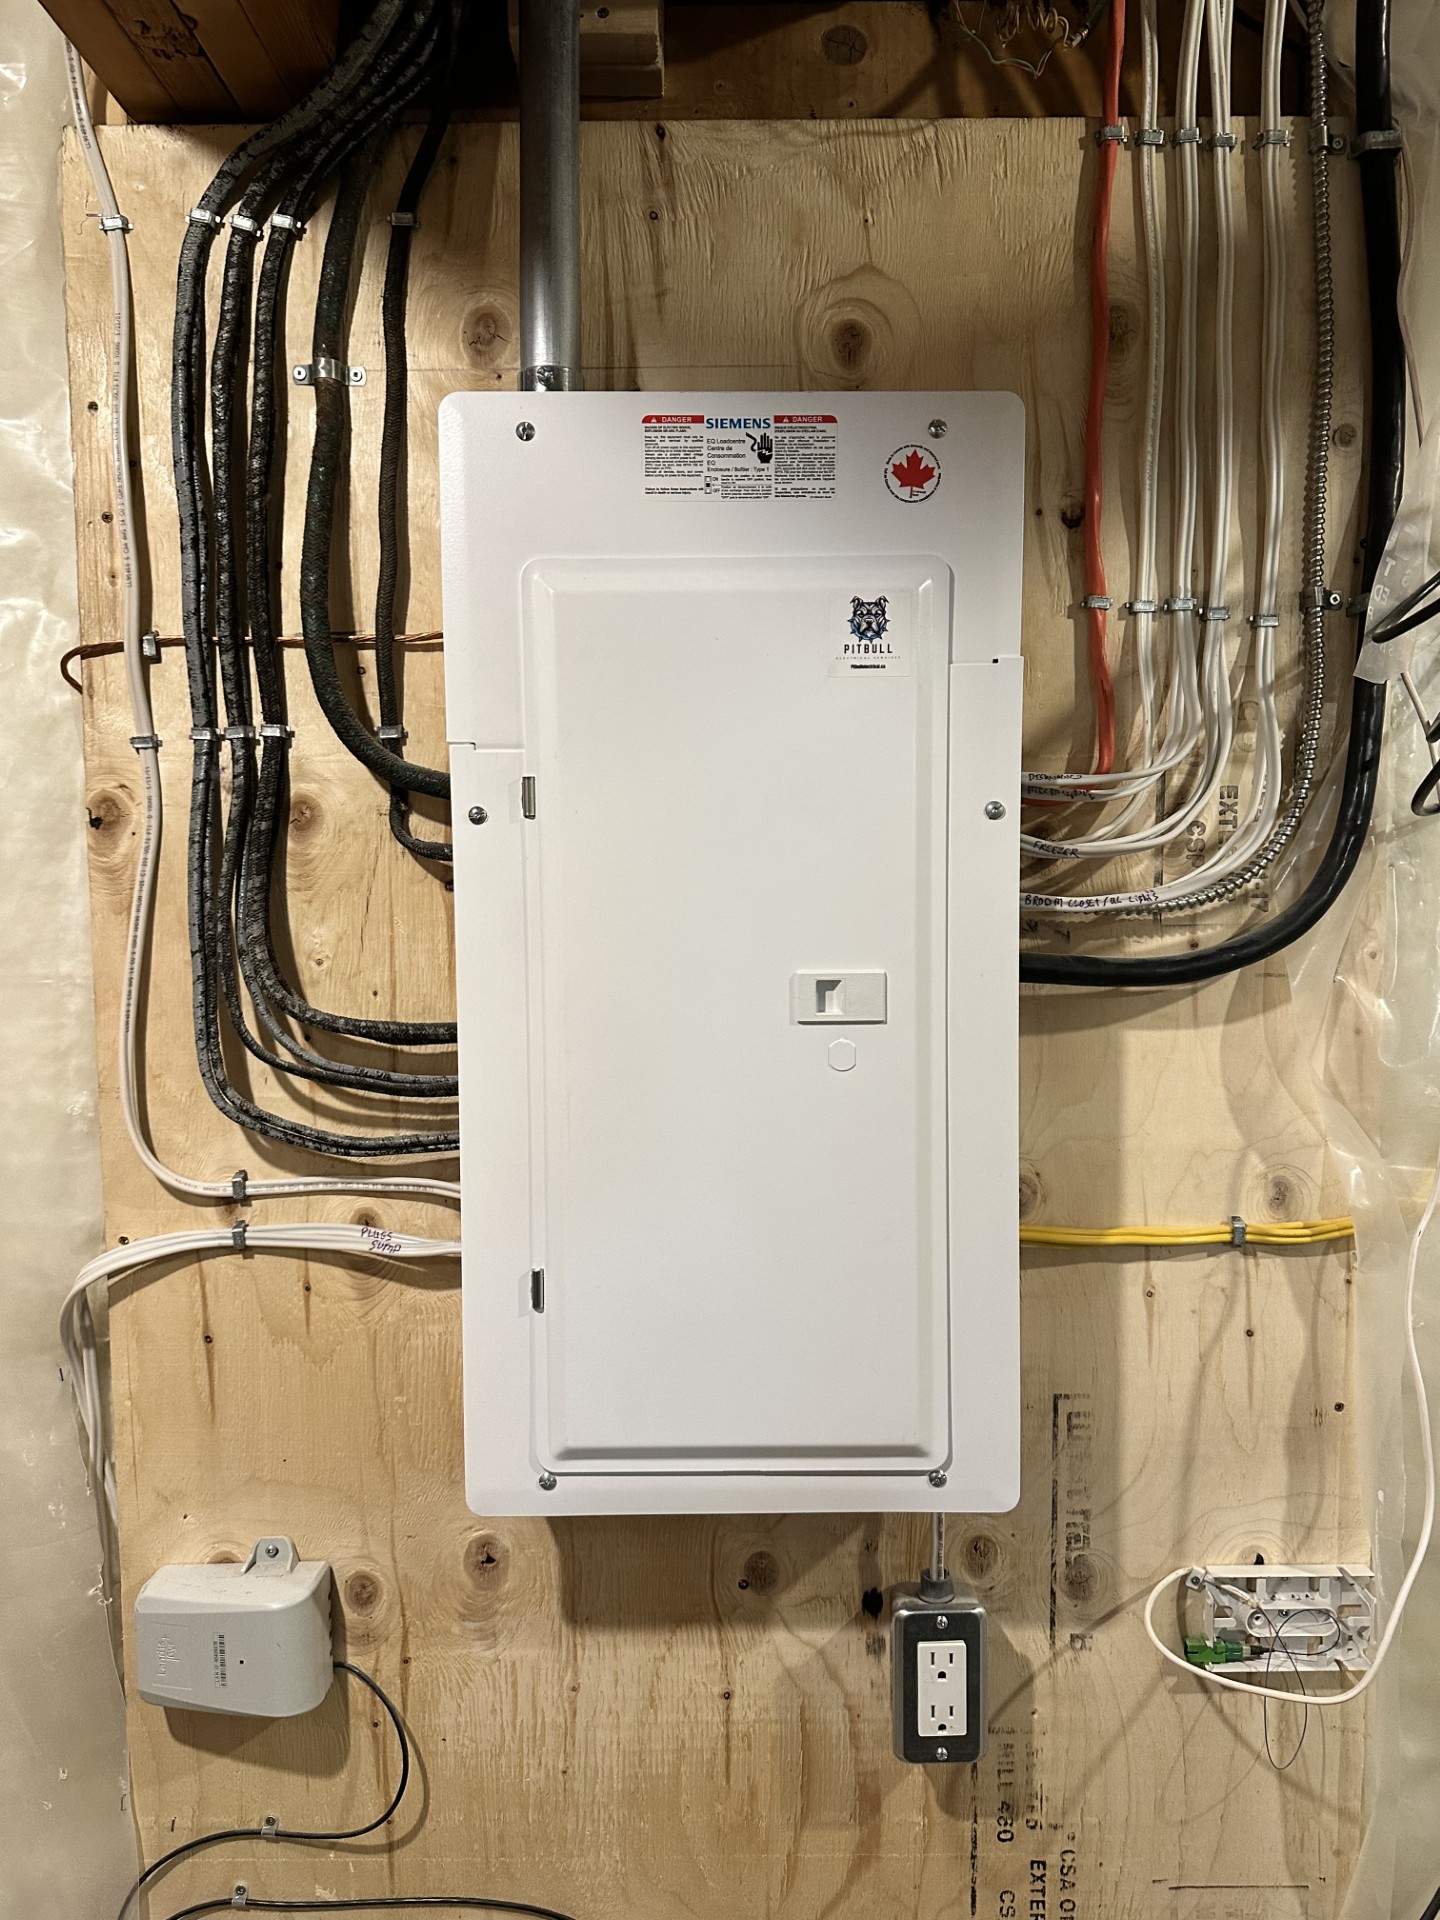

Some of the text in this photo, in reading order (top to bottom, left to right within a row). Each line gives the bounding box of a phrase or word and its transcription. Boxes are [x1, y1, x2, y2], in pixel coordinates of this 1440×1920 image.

[706, 418, 771, 429] SIEMENS
[844, 644, 893, 654] PITBULL
[143, 838, 151, 854] VOLTS
[1033, 840, 1080, 858] FREEZER
[1024, 894, 1063, 908] BROOM
[1067, 898, 1100, 909] CLOSET
[361, 1226, 393, 1241] PLUGS
[1059, 1849, 1076, 1891] CSA
